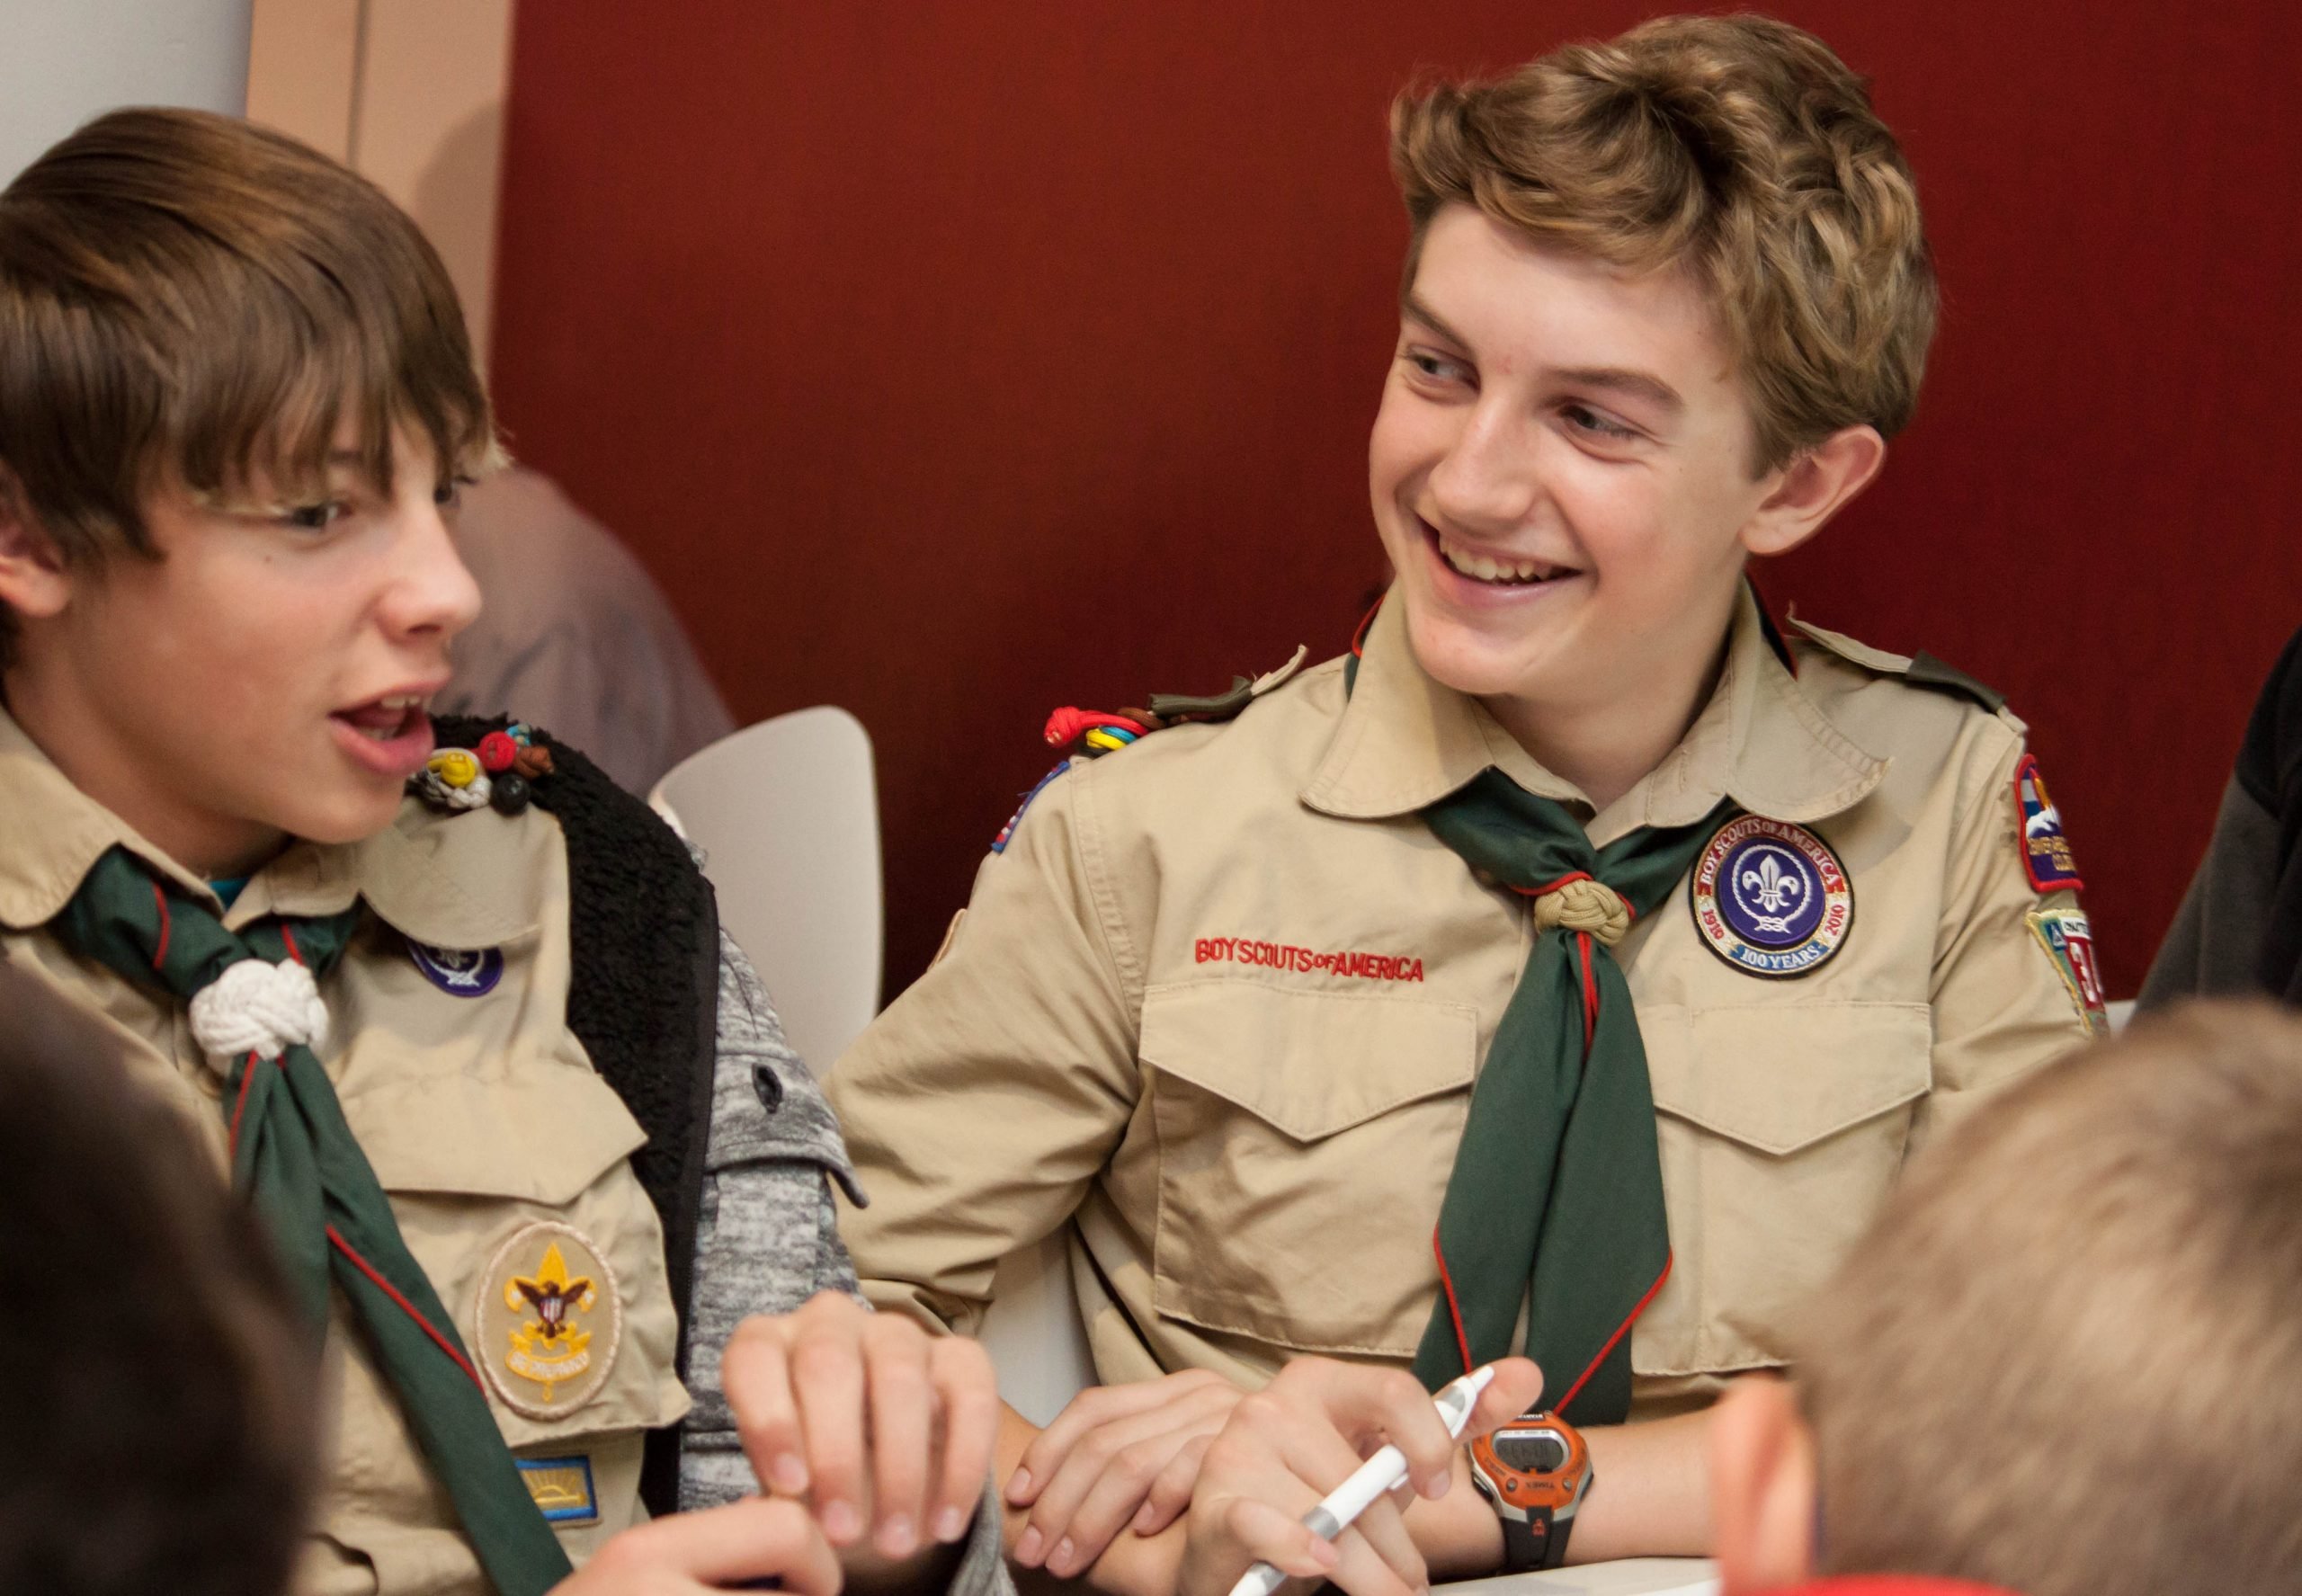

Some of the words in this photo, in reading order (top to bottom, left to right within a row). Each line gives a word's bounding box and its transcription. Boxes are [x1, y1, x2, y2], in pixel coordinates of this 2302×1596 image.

[1700, 851, 1719, 886] BOY
[1714, 818, 1762, 852] SCOUTS
[1777, 824, 1840, 886] AMERICA
[1700, 909, 1726, 941] 1910
[1824, 904, 1845, 937] 2010
[1195, 937, 1239, 964] BOY
[1237, 940, 1313, 973] SCOUTS
[1331, 951, 1423, 982] AMERICA
[1740, 948, 1769, 967] 100
[1766, 944, 1821, 969] YEARS
